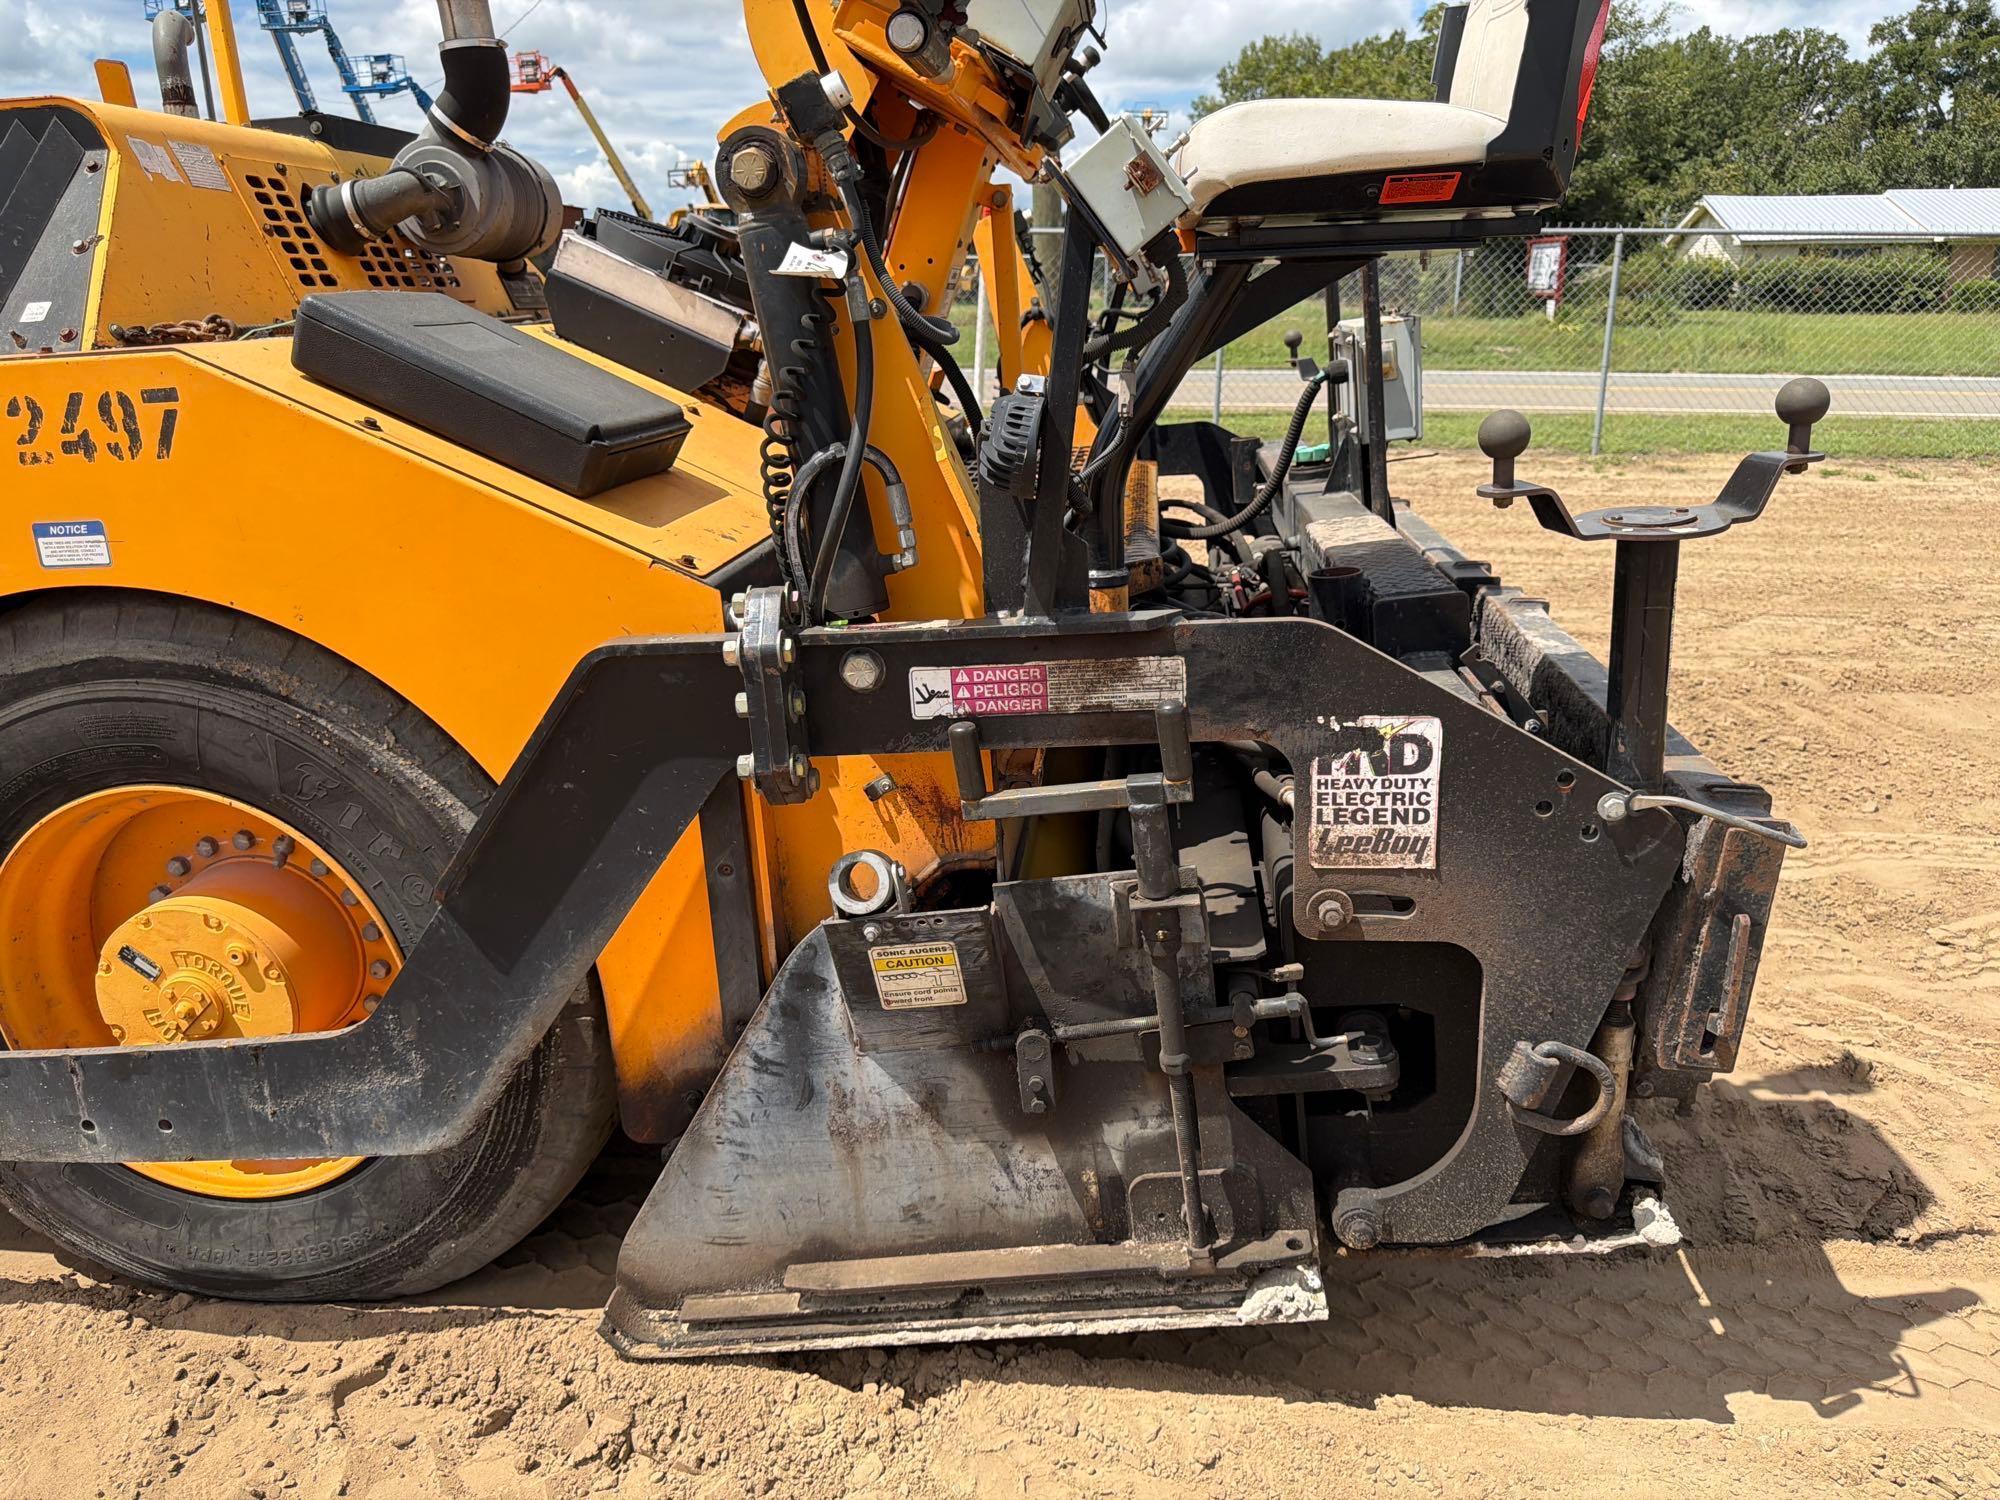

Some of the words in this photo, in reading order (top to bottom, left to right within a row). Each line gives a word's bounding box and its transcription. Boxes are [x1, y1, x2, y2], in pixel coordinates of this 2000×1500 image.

[6, 387, 179, 465] 2497
[49, 524, 88, 535] NOTICE
[973, 668, 1041, 682] DANGER
[973, 683, 1044, 698] PELIGRO
[976, 698, 1043, 712] DANGER
[1317, 778, 1378, 790] HEAVY
[1381, 778, 1432, 790] DUTY
[1316, 791, 1432, 806] ELECTRIC
[1316, 807, 1431, 825] LEGEND
[1316, 827, 1431, 864] LeeBoy
[876, 949, 906, 957] SONIC
[908, 946, 948, 955] AUGERS
[886, 956, 944, 968] CAUTION
[173, 952, 251, 1018] TORQUE
[883, 990, 912, 998] Ensure
[913, 988, 931, 996] cord
[933, 986, 958, 995] points
